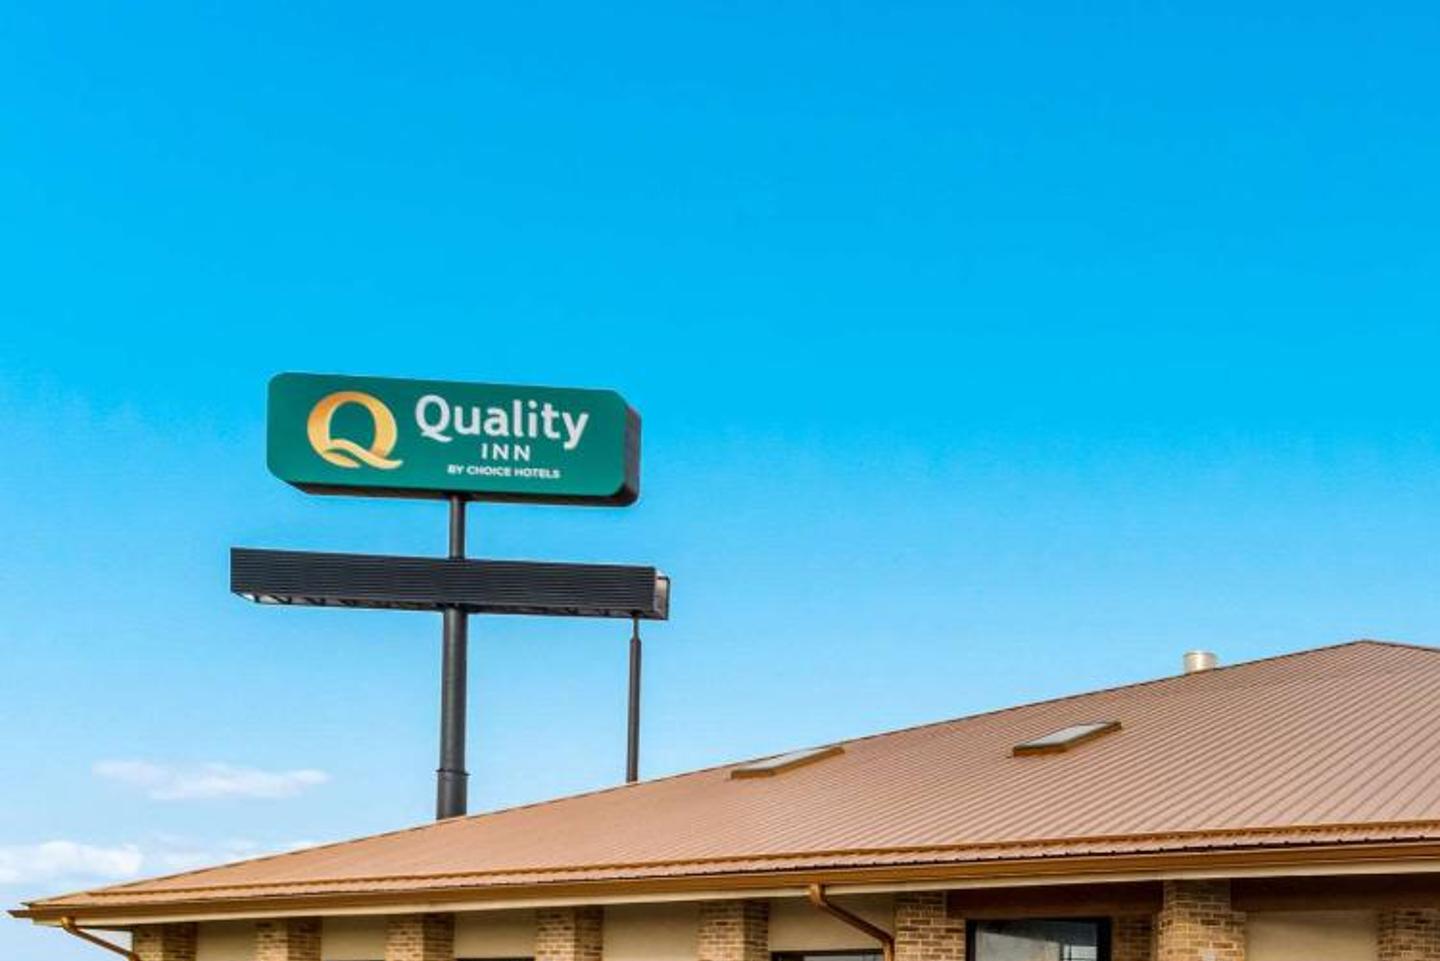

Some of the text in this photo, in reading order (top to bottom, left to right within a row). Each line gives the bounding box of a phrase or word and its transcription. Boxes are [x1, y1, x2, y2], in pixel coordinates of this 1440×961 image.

[415, 394, 589, 450] Quality
[481, 442, 531, 461] INN
[447, 464, 560, 479] BY CHOICE HOTELS
